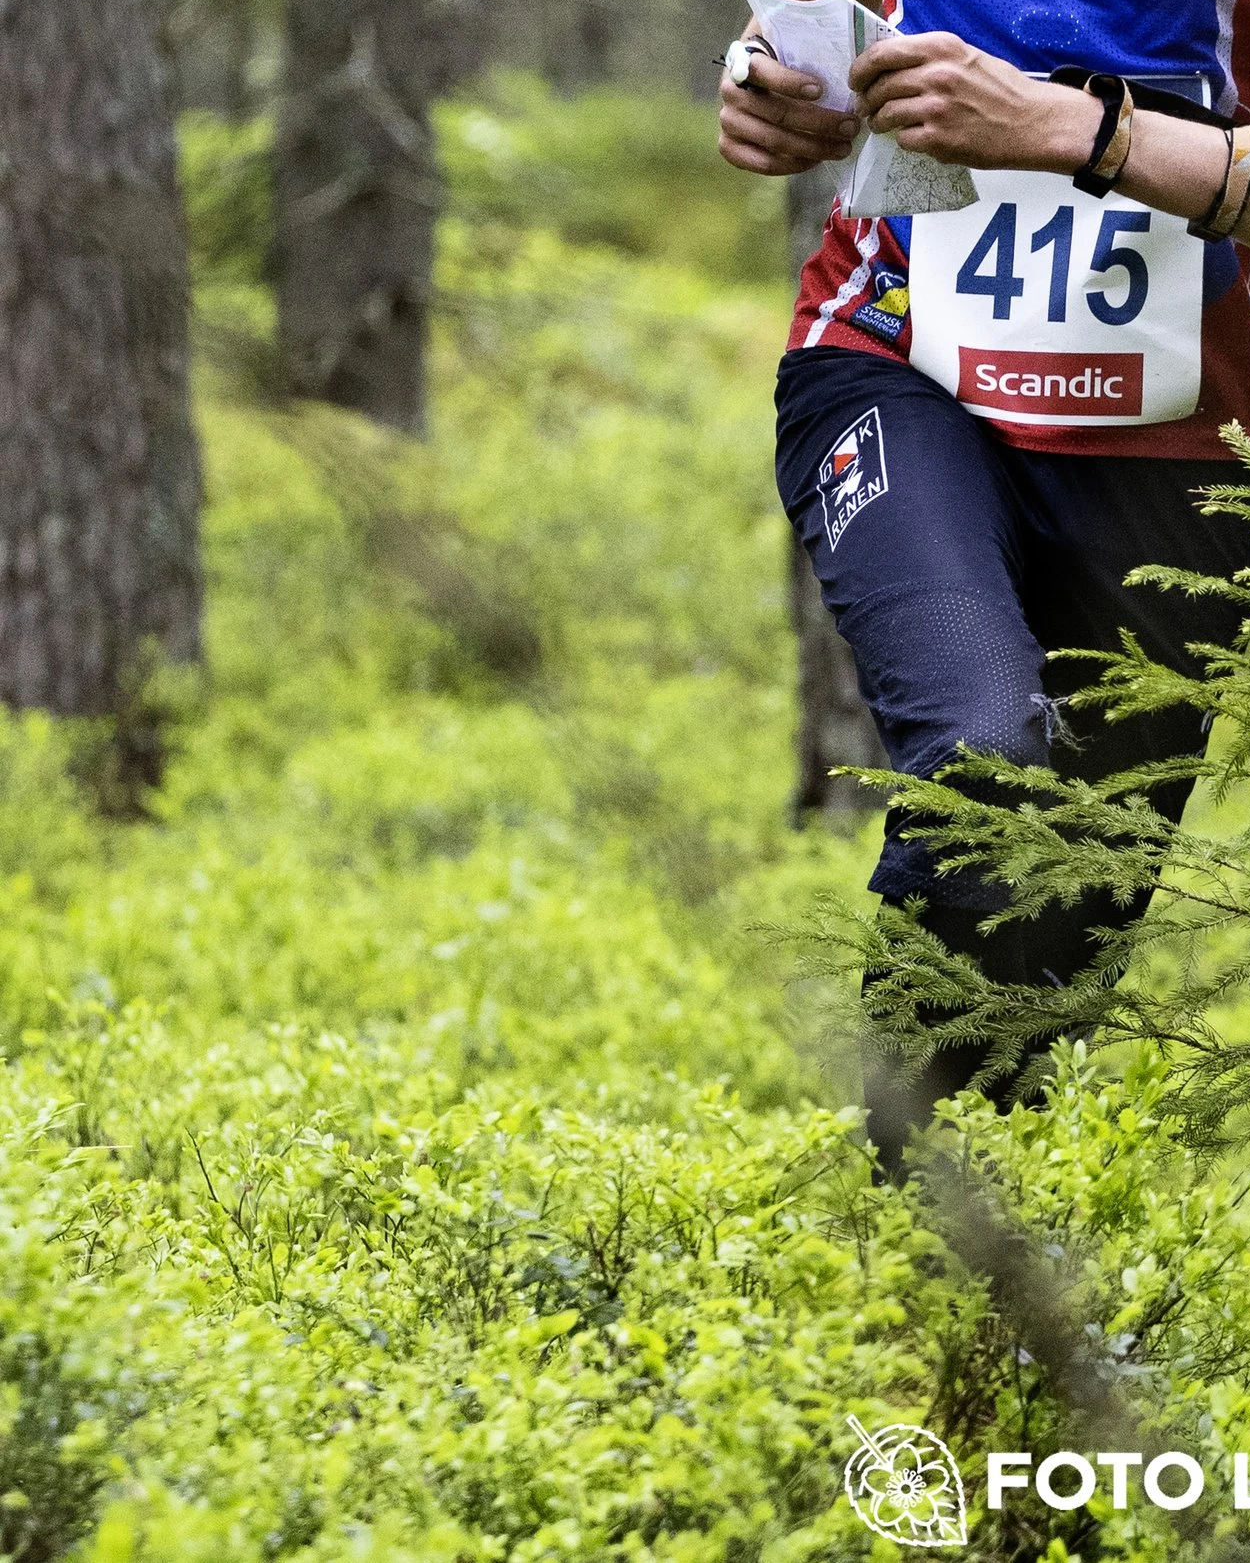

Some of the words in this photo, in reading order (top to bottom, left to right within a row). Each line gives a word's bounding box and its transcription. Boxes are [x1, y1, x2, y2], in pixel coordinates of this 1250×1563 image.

[956, 202, 1152, 326] 415
[861, 305, 902, 330] SVENSK
[975, 364, 1124, 399] Scandic
[859, 419, 874, 443] K
[831, 476, 881, 540] RENEN
